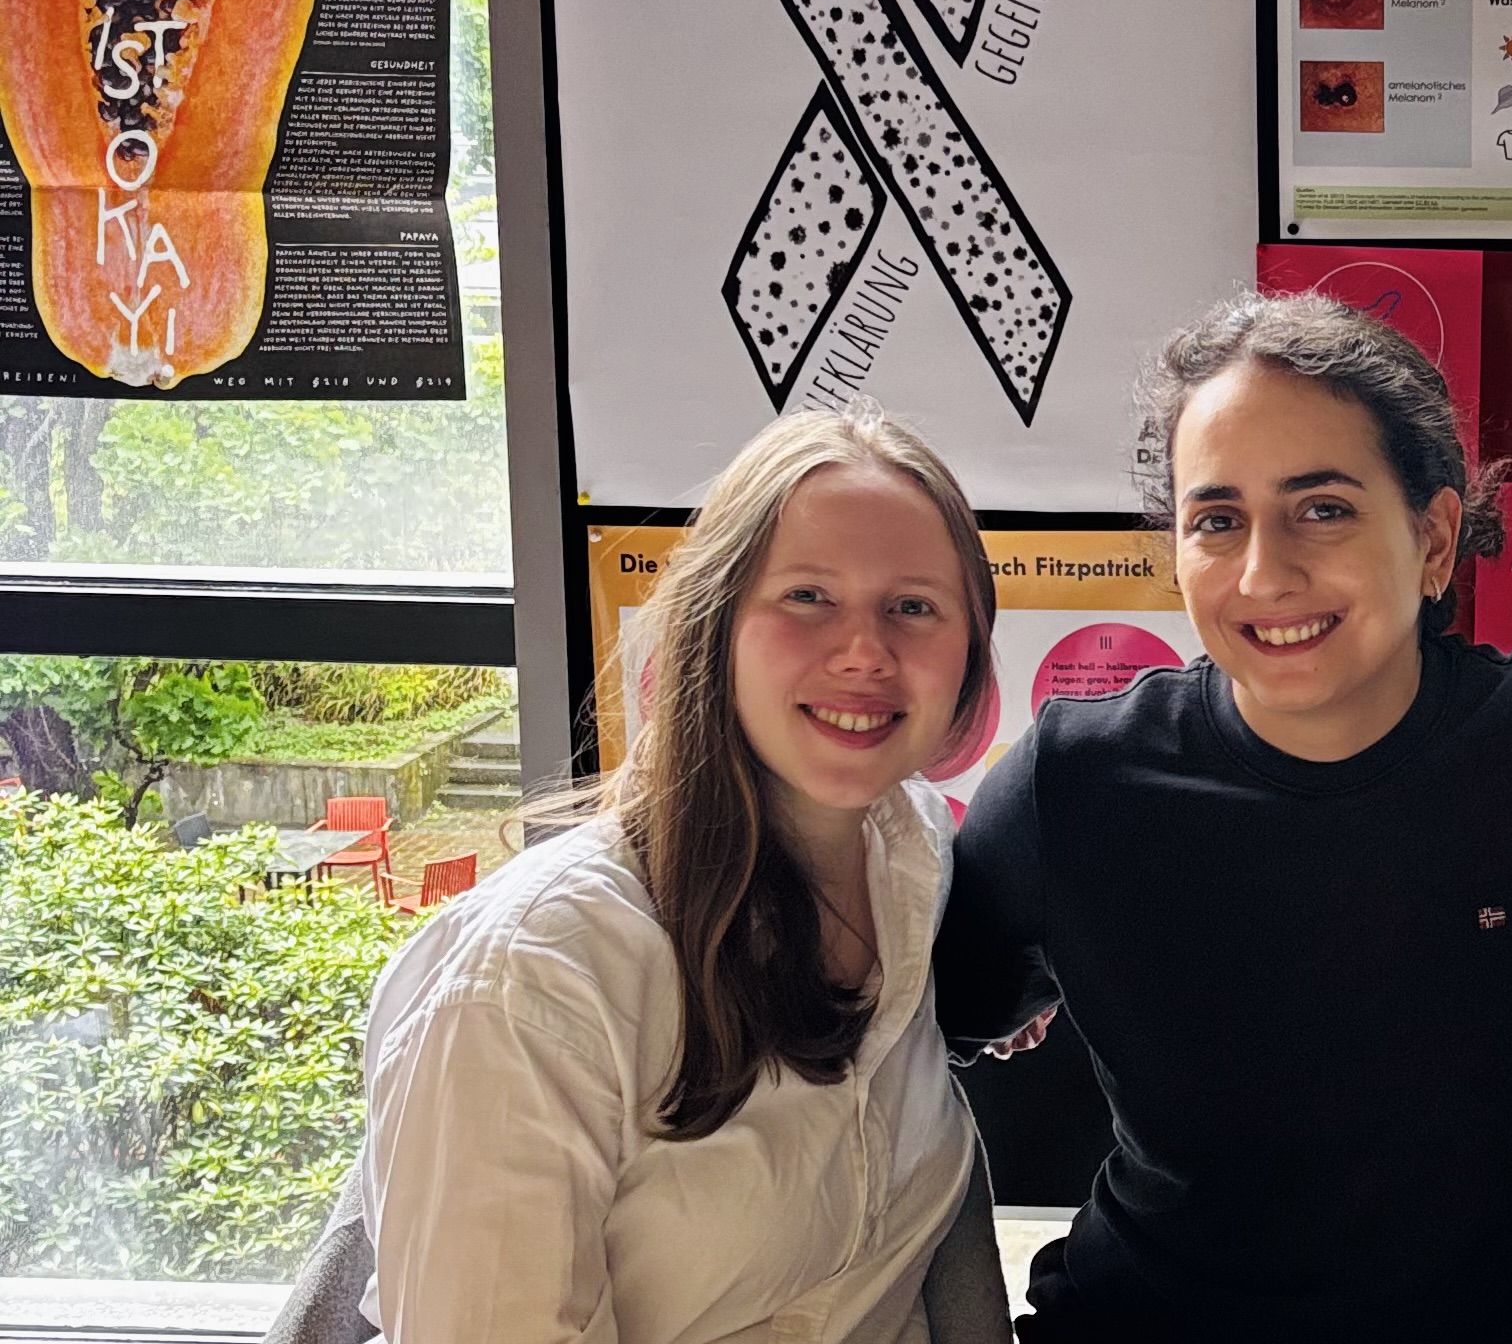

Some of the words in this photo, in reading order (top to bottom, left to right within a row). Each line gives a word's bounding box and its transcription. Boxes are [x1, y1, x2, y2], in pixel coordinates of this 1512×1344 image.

[1391, 0, 1438, 8] Melanom
[95, 8, 187, 99] IST
[371, 61, 435, 70] GESUNDHEIT
[1388, 81, 1466, 90] amelanotisches
[1388, 93, 1435, 102] Melanom
[401, 232, 438, 241] PAPAYA
[97, 130, 190, 377] OKAY!
[802, 249, 919, 410] UFKLÄRUNG
[213, 377, 247, 386] WEG
[264, 376, 295, 386] MIT
[366, 376, 398, 386] UND
[620, 553, 658, 573] Die
[989, 557, 1026, 576] ach
[1036, 556, 1155, 581] Fitzpatrick
[1052, 676, 1084, 684] Augen:
